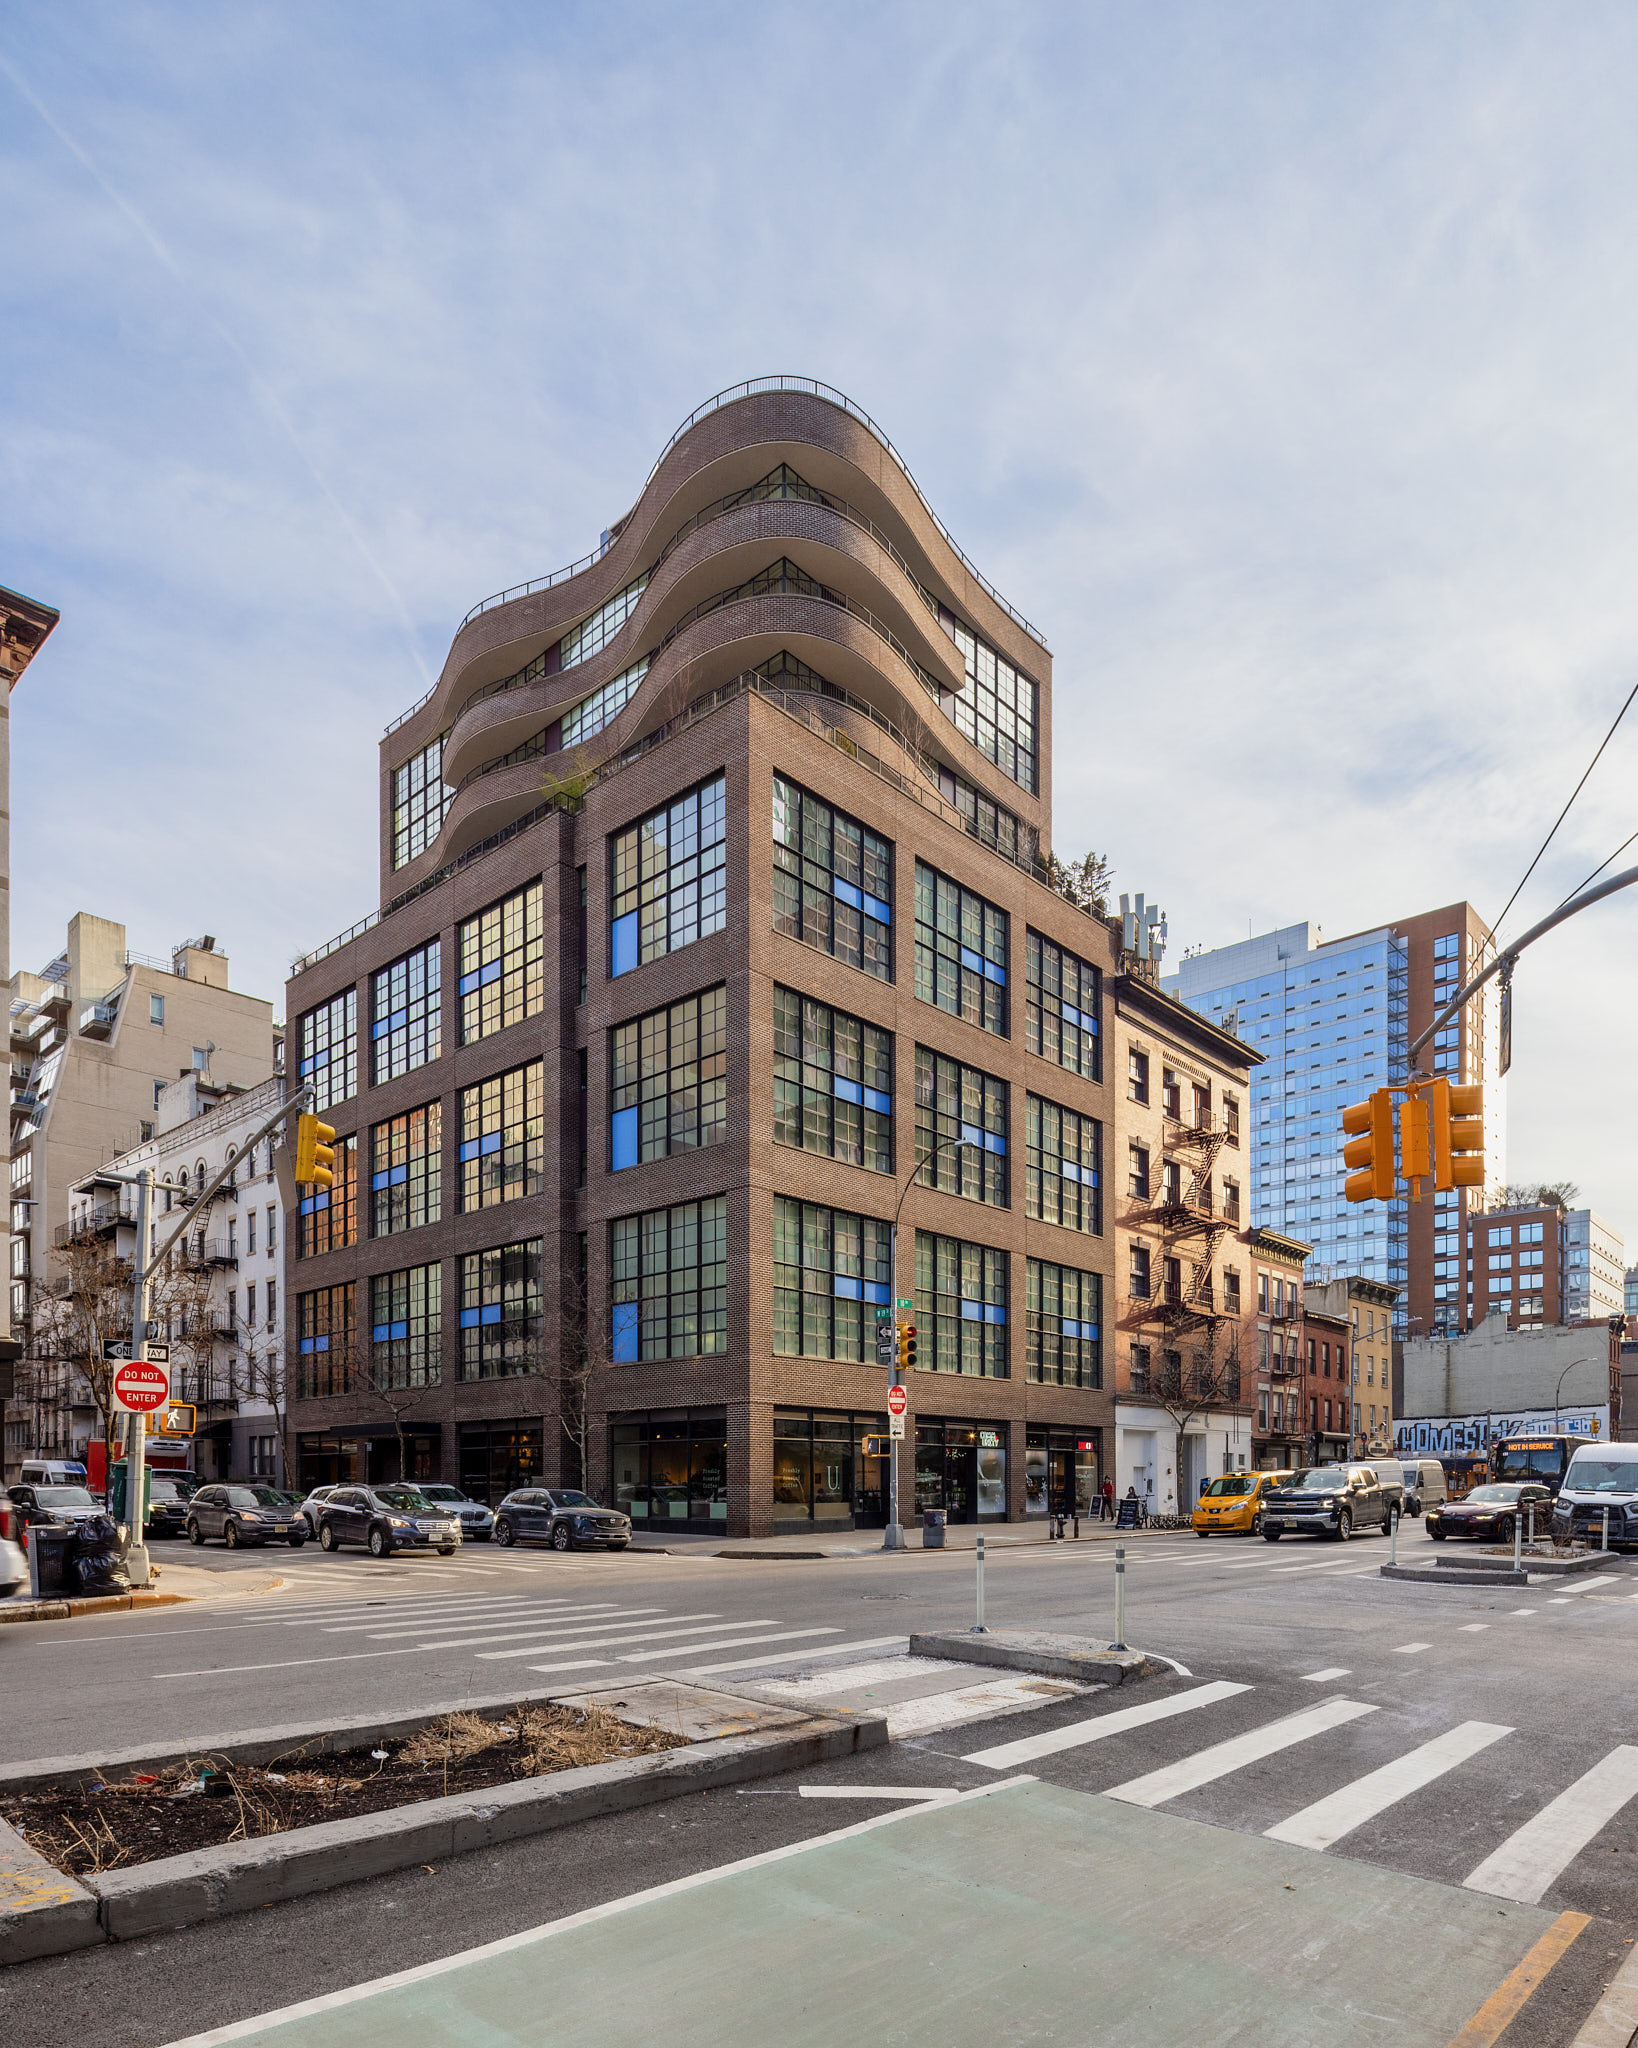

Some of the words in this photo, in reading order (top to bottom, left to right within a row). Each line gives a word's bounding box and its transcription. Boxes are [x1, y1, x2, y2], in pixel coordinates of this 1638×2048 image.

[116, 1347, 133, 1356] ONE
[124, 1370, 138, 1379] DO
[141, 1371, 159, 1380] NOT
[126, 1393, 157, 1402] ENTER
[1508, 1443, 1521, 1451] NOT
[1529, 1442, 1554, 1450] SERVICE
